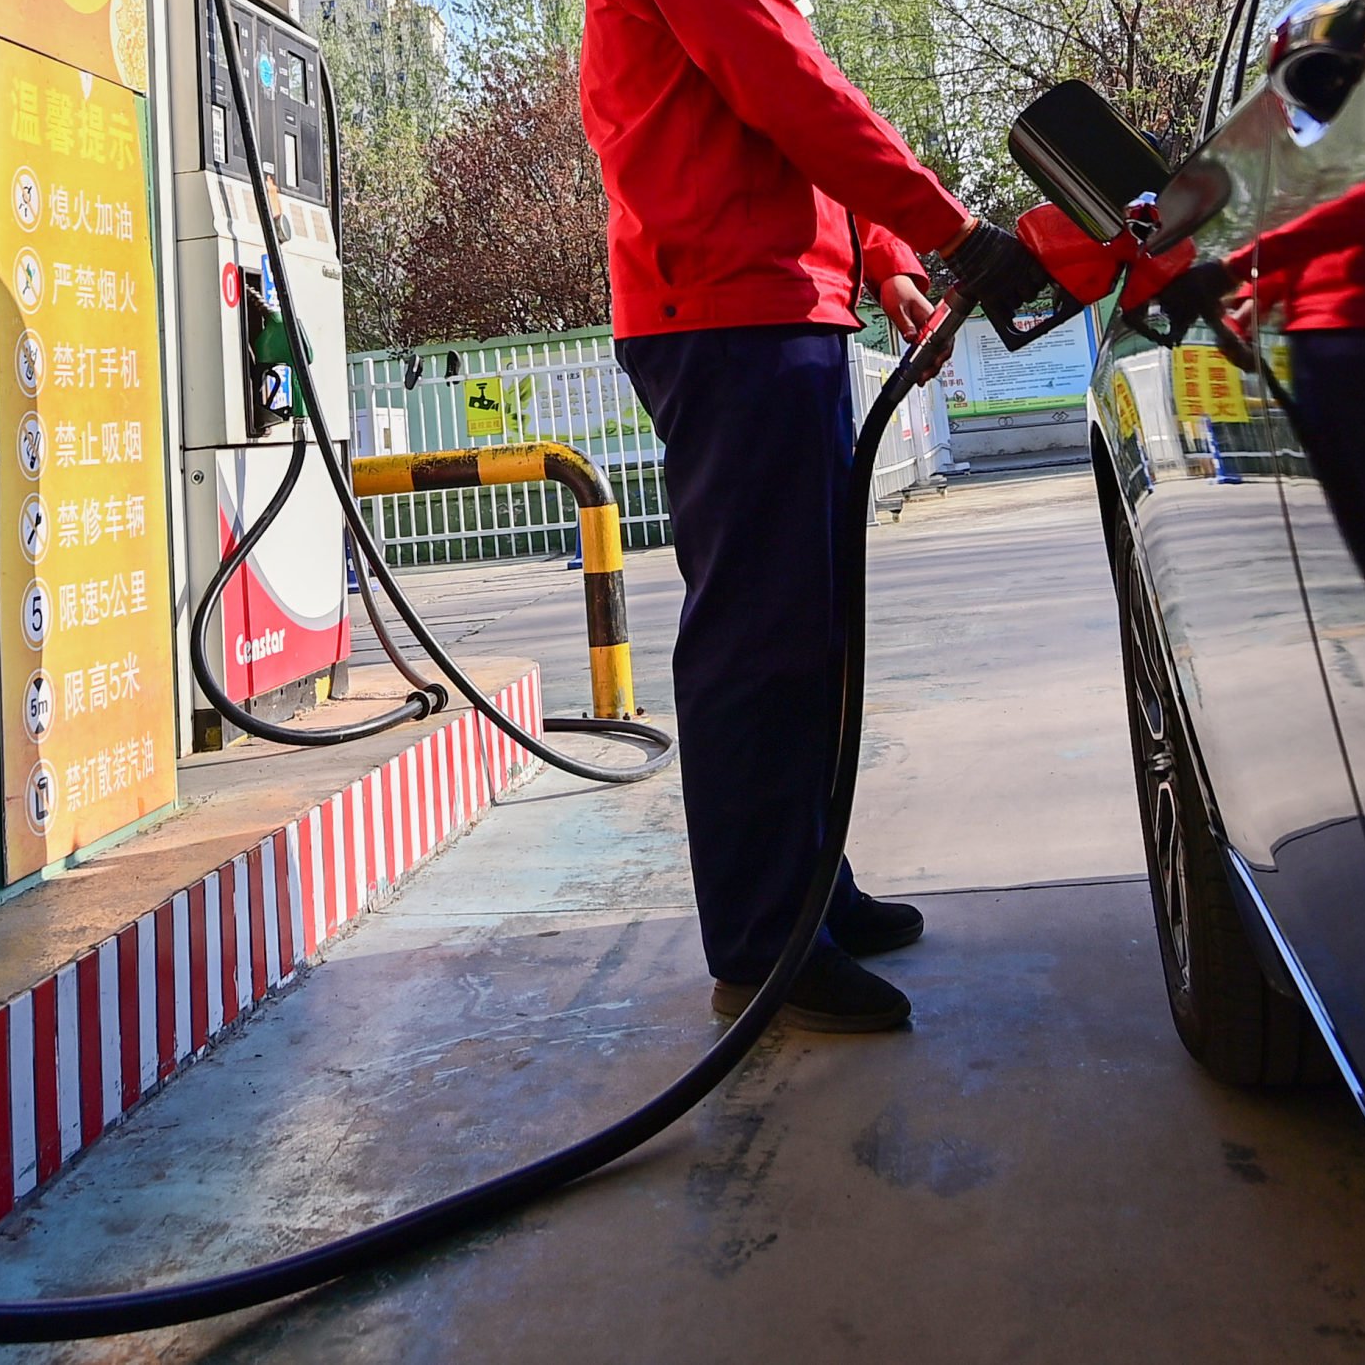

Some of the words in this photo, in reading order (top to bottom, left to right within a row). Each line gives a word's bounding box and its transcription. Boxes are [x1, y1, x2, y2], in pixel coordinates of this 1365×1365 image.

[11, 76, 136, 171] 温馨提示
[49, 183, 133, 242] 熄火加油
[52, 262, 138, 314] 严禁烟火
[53, 342, 140, 389] 禁打手机
[55, 420, 142, 468] 禁止吸烟
[57, 493, 146, 548] 禁修车辆
[31, 596, 43, 632] 5
[59, 570, 148, 632] 限速5公里
[236, 628, 286, 665] Censtar
[30, 698, 49, 718] 5m
[63, 651, 141, 721] 限高5米
[65, 730, 155, 812] 禁打散装汽油
